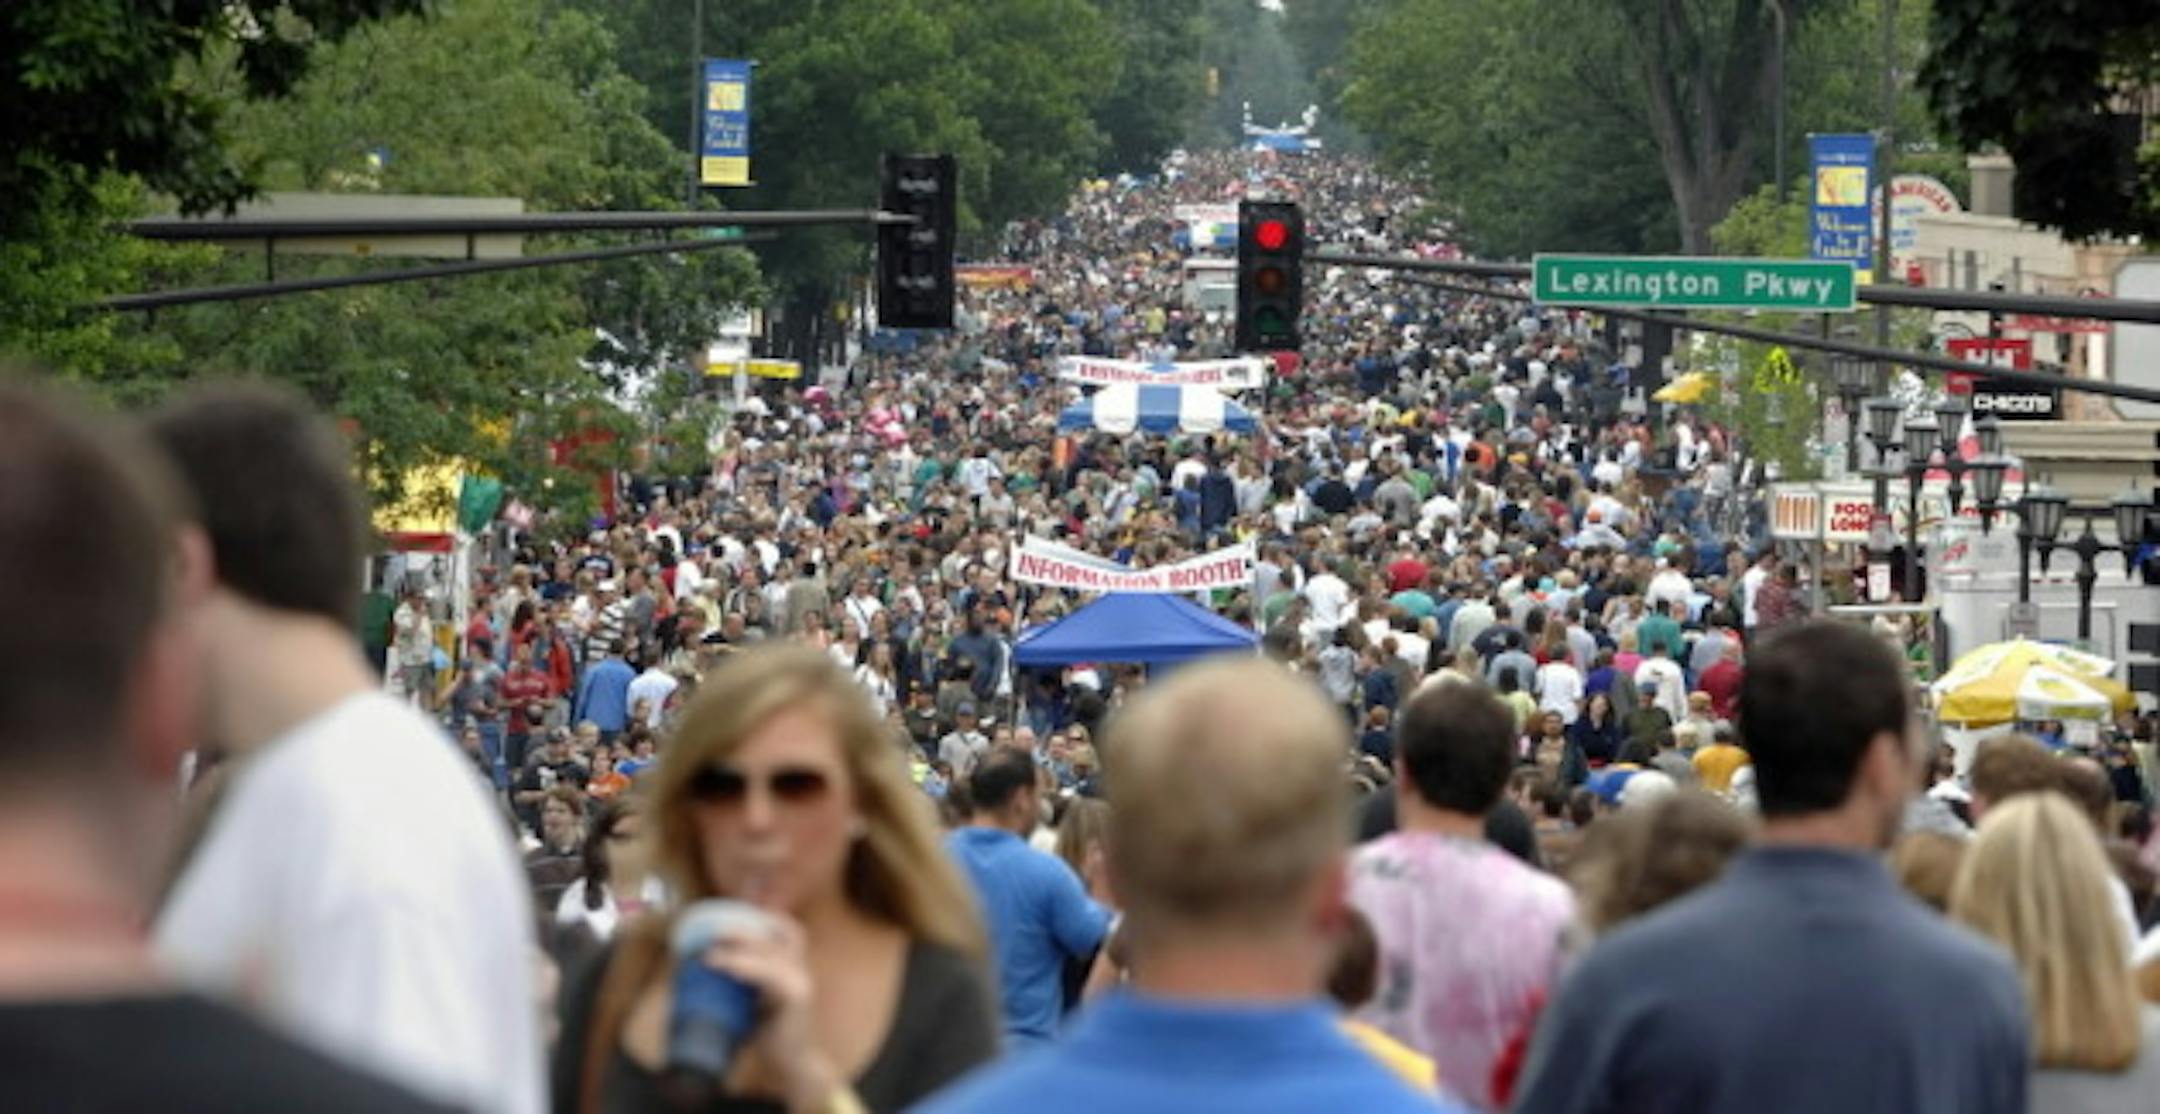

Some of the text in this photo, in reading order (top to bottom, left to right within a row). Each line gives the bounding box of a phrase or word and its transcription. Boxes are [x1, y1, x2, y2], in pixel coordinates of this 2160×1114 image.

[1551, 267, 1834, 303] Lexington Pkwy
[1834, 502, 1873, 514] FOO
[1018, 554, 1245, 589] INFORMATION BOOTH
